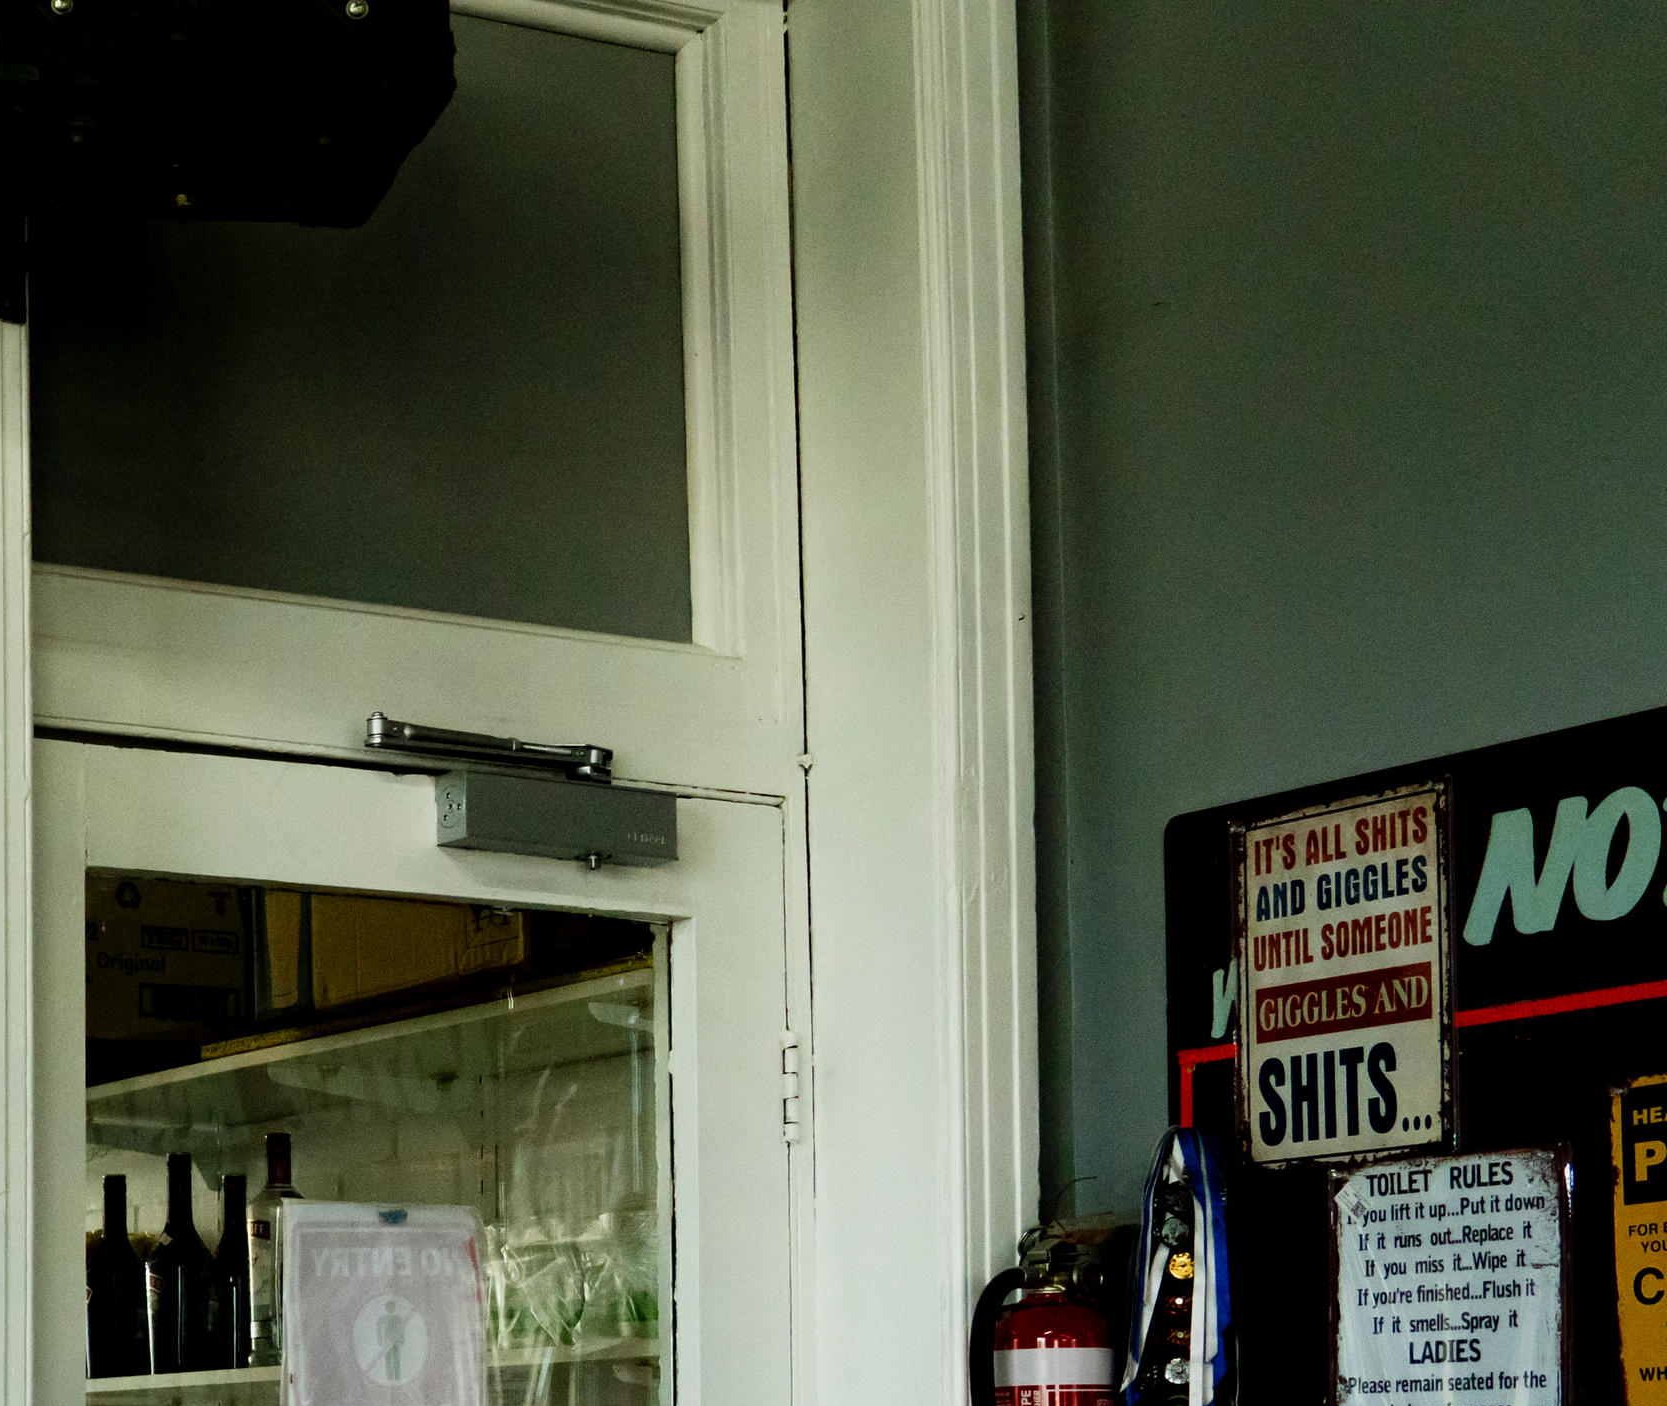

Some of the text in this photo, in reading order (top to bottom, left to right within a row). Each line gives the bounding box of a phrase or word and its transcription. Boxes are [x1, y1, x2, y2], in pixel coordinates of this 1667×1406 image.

[1255, 806, 1427, 876] IT'S ALL SHITS
[1462, 786, 1667, 946] NO
[1257, 855, 1427, 921] AND GIGGLES
[1254, 906, 1433, 971] UNTIL SOMEONE
[97, 952, 165, 975] Original
[1259, 984, 1367, 1033] GIGGLES
[1374, 974, 1429, 1014] AND
[1258, 1042, 1433, 1148] SHITS...
[1366, 1162, 1513, 1196] TOILET RULES
[1363, 1210, 1386, 1227] you
[1391, 1204, 1410, 1221] lift
[1415, 1203, 1424, 1218] it
[1491, 1195, 1500, 1212] it
[1505, 1194, 1545, 1211] down
[1359, 1221, 1532, 1250] If it runs it
[1365, 1250, 1525, 1279] If you miss it
[1358, 1279, 1535, 1308] If you're it
[1373, 1310, 1518, 1334] If it it
[1410, 1339, 1481, 1364] LADIES
[1347, 1371, 1546, 1394] Please remain seated for the
